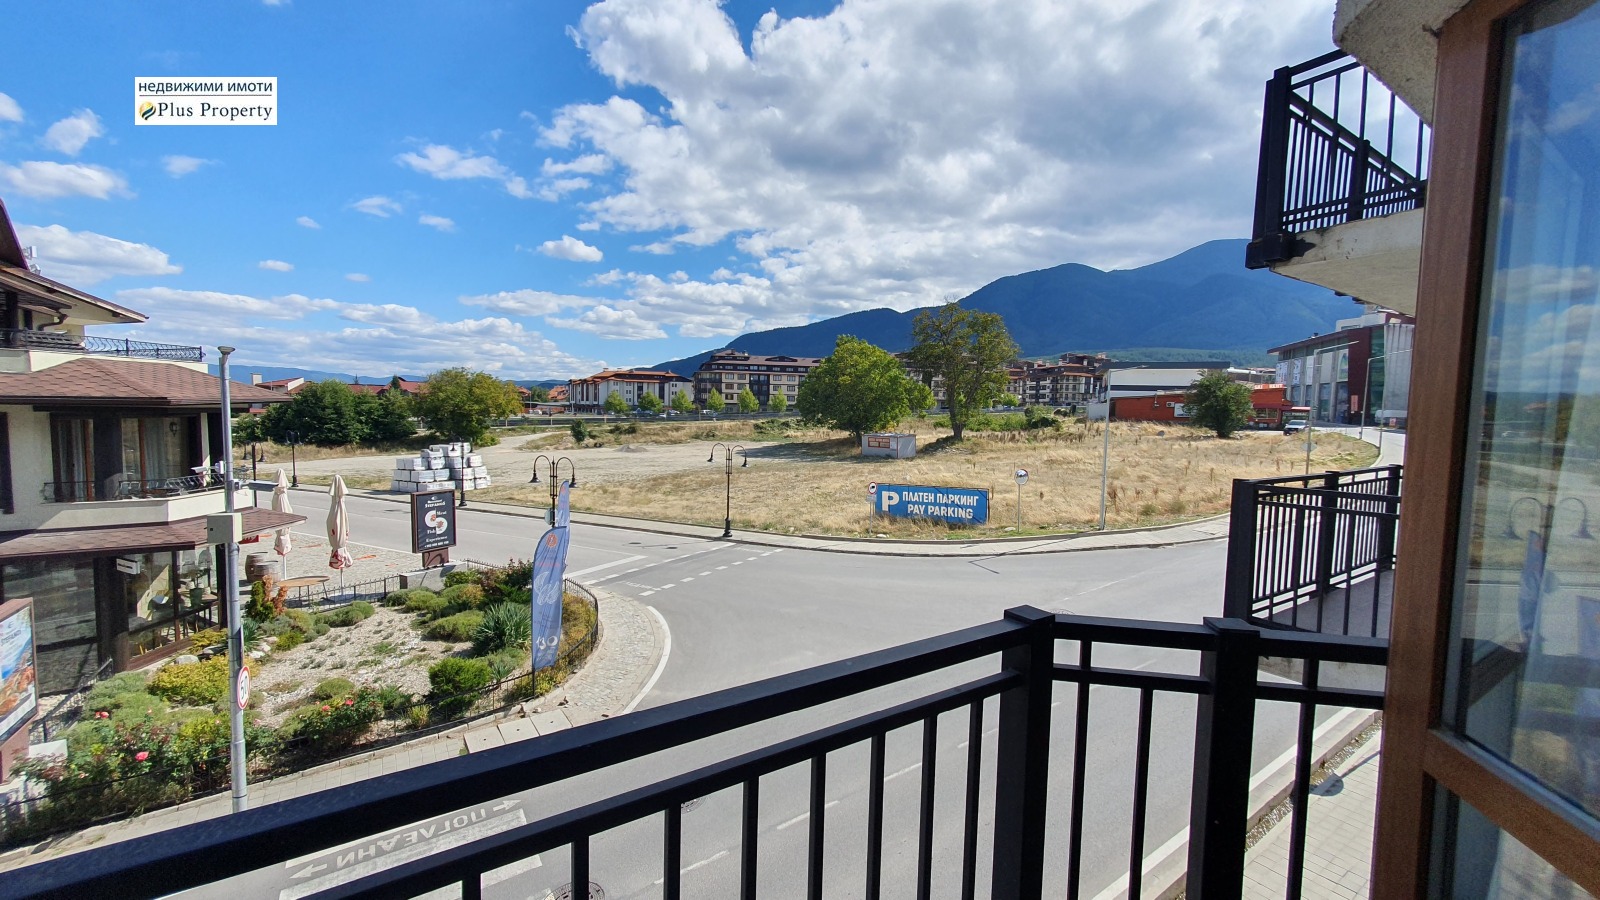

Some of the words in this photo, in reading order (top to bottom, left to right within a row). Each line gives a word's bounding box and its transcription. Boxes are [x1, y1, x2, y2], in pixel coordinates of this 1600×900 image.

[882, 491, 900, 512] P
[902, 491, 935, 503] ПЛАТЕН
[936, 493, 979, 506] ПАРКИНГ
[907, 504, 926, 515] PAY
[928, 505, 974, 519] PARKING
[336, 808, 486, 870] ПОГЛЕДНИ
